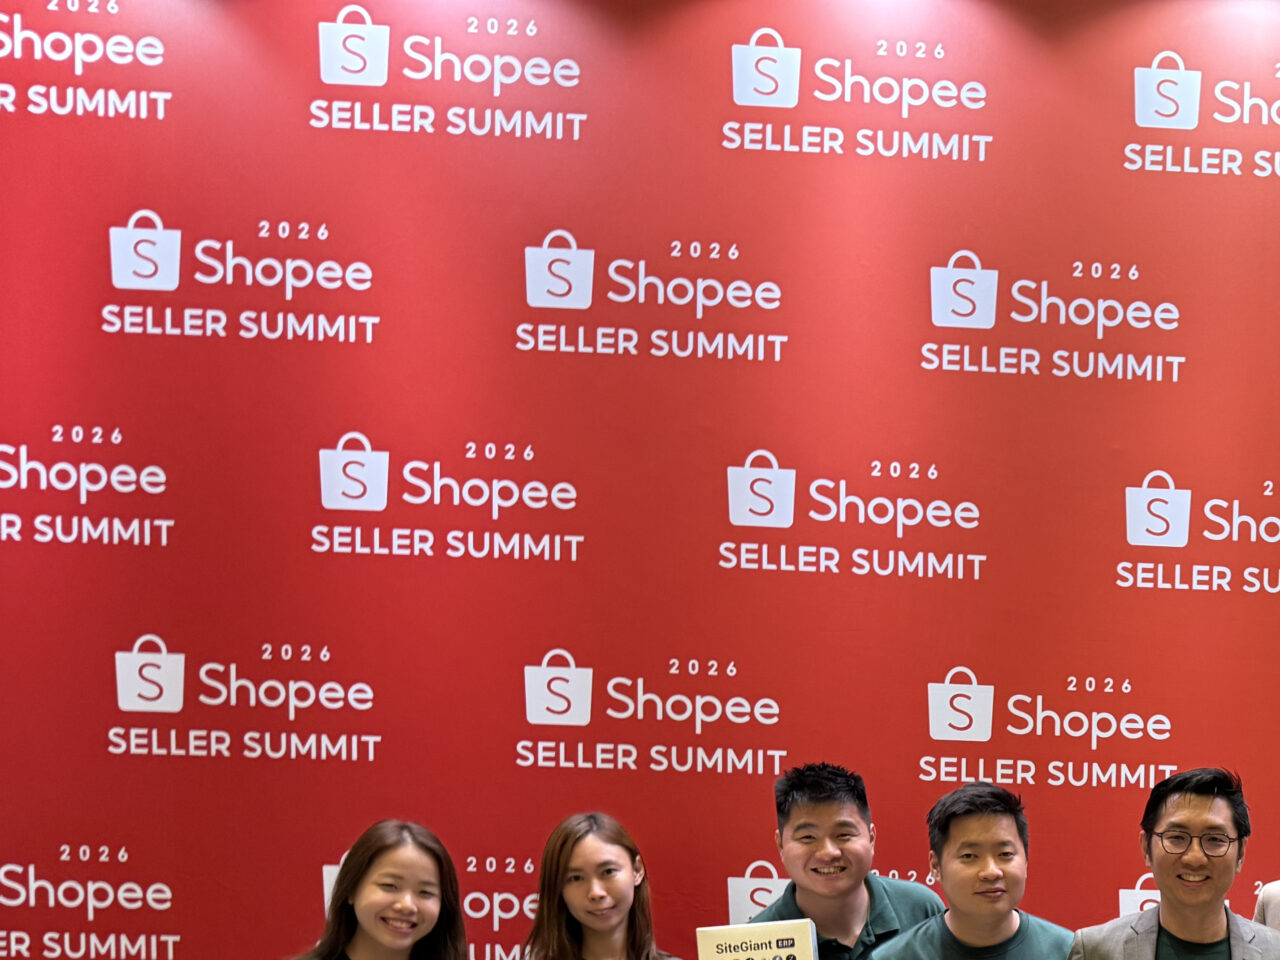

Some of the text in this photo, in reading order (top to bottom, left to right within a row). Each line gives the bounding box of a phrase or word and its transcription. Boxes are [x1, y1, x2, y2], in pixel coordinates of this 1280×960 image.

[467, 17, 538, 37] 2026
[402, 35, 581, 97] Shopee
[877, 39, 945, 59] 2026
[26, 84, 173, 120] SUMMIT
[813, 57, 987, 119] Shopee
[308, 99, 588, 141] SELLER SUMMIT
[721, 120, 994, 162] SELLER SUMMIT
[1122, 142, 1243, 176] SELLER
[258, 219, 329, 241] 2026
[670, 240, 740, 260] 2026
[193, 238, 373, 301] Shopee
[1072, 260, 1140, 281] 2026
[606, 258, 782, 320] Shopee
[101, 303, 381, 344] SELLER SUMMIT
[1009, 279, 1181, 340] Shopee
[515, 322, 789, 362] SELLER SUMMIT
[920, 342, 1187, 383] SELLER SUMMIT
[51, 424, 123, 444] 2026
[465, 441, 535, 462] 2026
[870, 459, 939, 480] 2026
[401, 460, 578, 521] Shopee
[808, 478, 981, 539] Shopee
[33, 514, 176, 547] SUMMIT
[310, 524, 585, 562] SELLER SUMMIT
[717, 541, 988, 581] SELLER SUMMIT
[1115, 561, 1232, 592] SELLER
[261, 642, 331, 663] 2026
[668, 657, 738, 677] 2026
[198, 661, 375, 722] Shopee
[1066, 675, 1132, 694] 2026
[605, 676, 780, 735] Shopee
[1005, 693, 1172, 751] Shopee
[107, 726, 382, 762] SELLER SUMMIT
[515, 739, 788, 776] SELLER SUMMIT
[918, 755, 1179, 790] SELLER SUMMIT
[59, 844, 129, 862] 2026
[466, 856, 535, 874] 2026
[0, 863, 173, 921] Shopee
[42, 931, 181, 960] SUMMIT
[716, 940, 773, 955] SiteGiant
